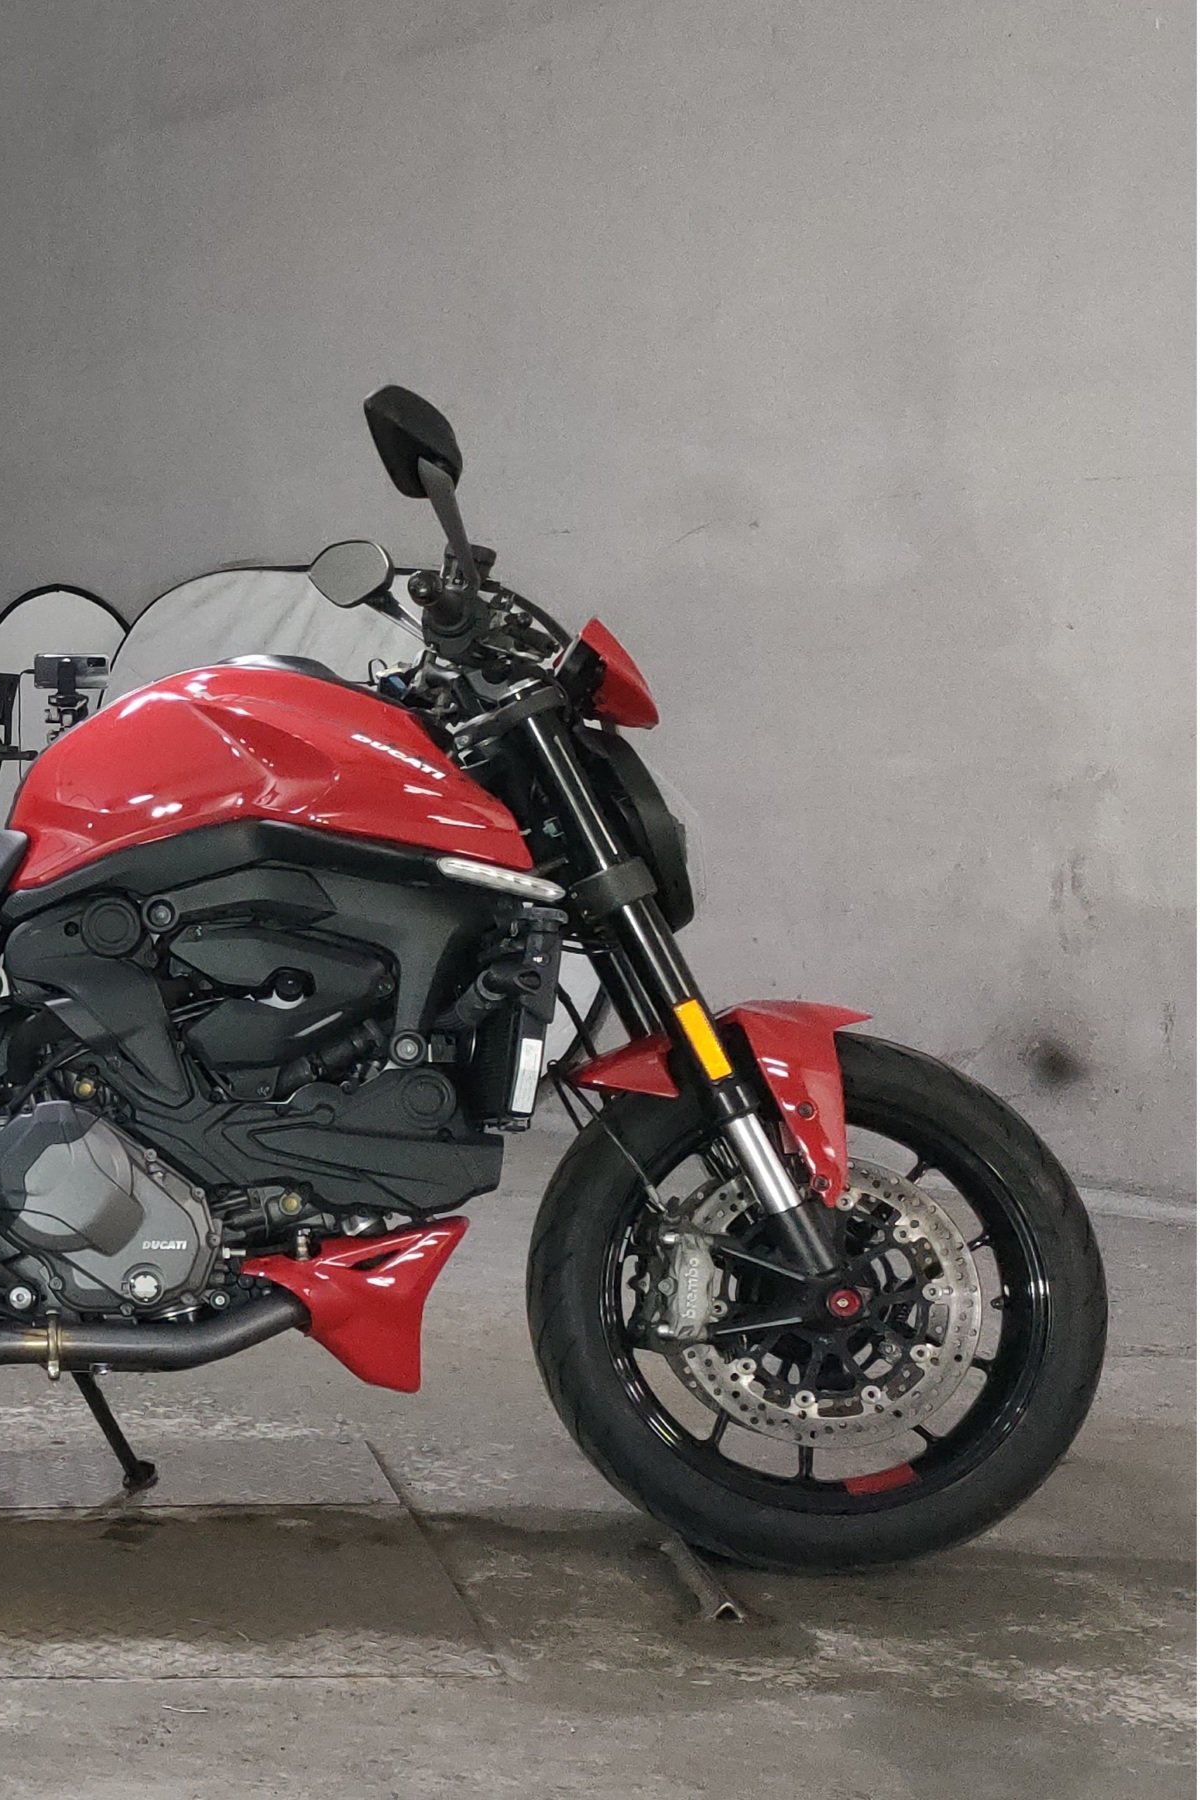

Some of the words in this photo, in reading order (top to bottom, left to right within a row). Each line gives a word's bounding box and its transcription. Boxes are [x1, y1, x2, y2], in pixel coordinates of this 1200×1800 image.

[351, 733, 446, 780] DUCATI
[142, 1240, 188, 1250] DUCATI
[682, 1257, 700, 1319] brembo
